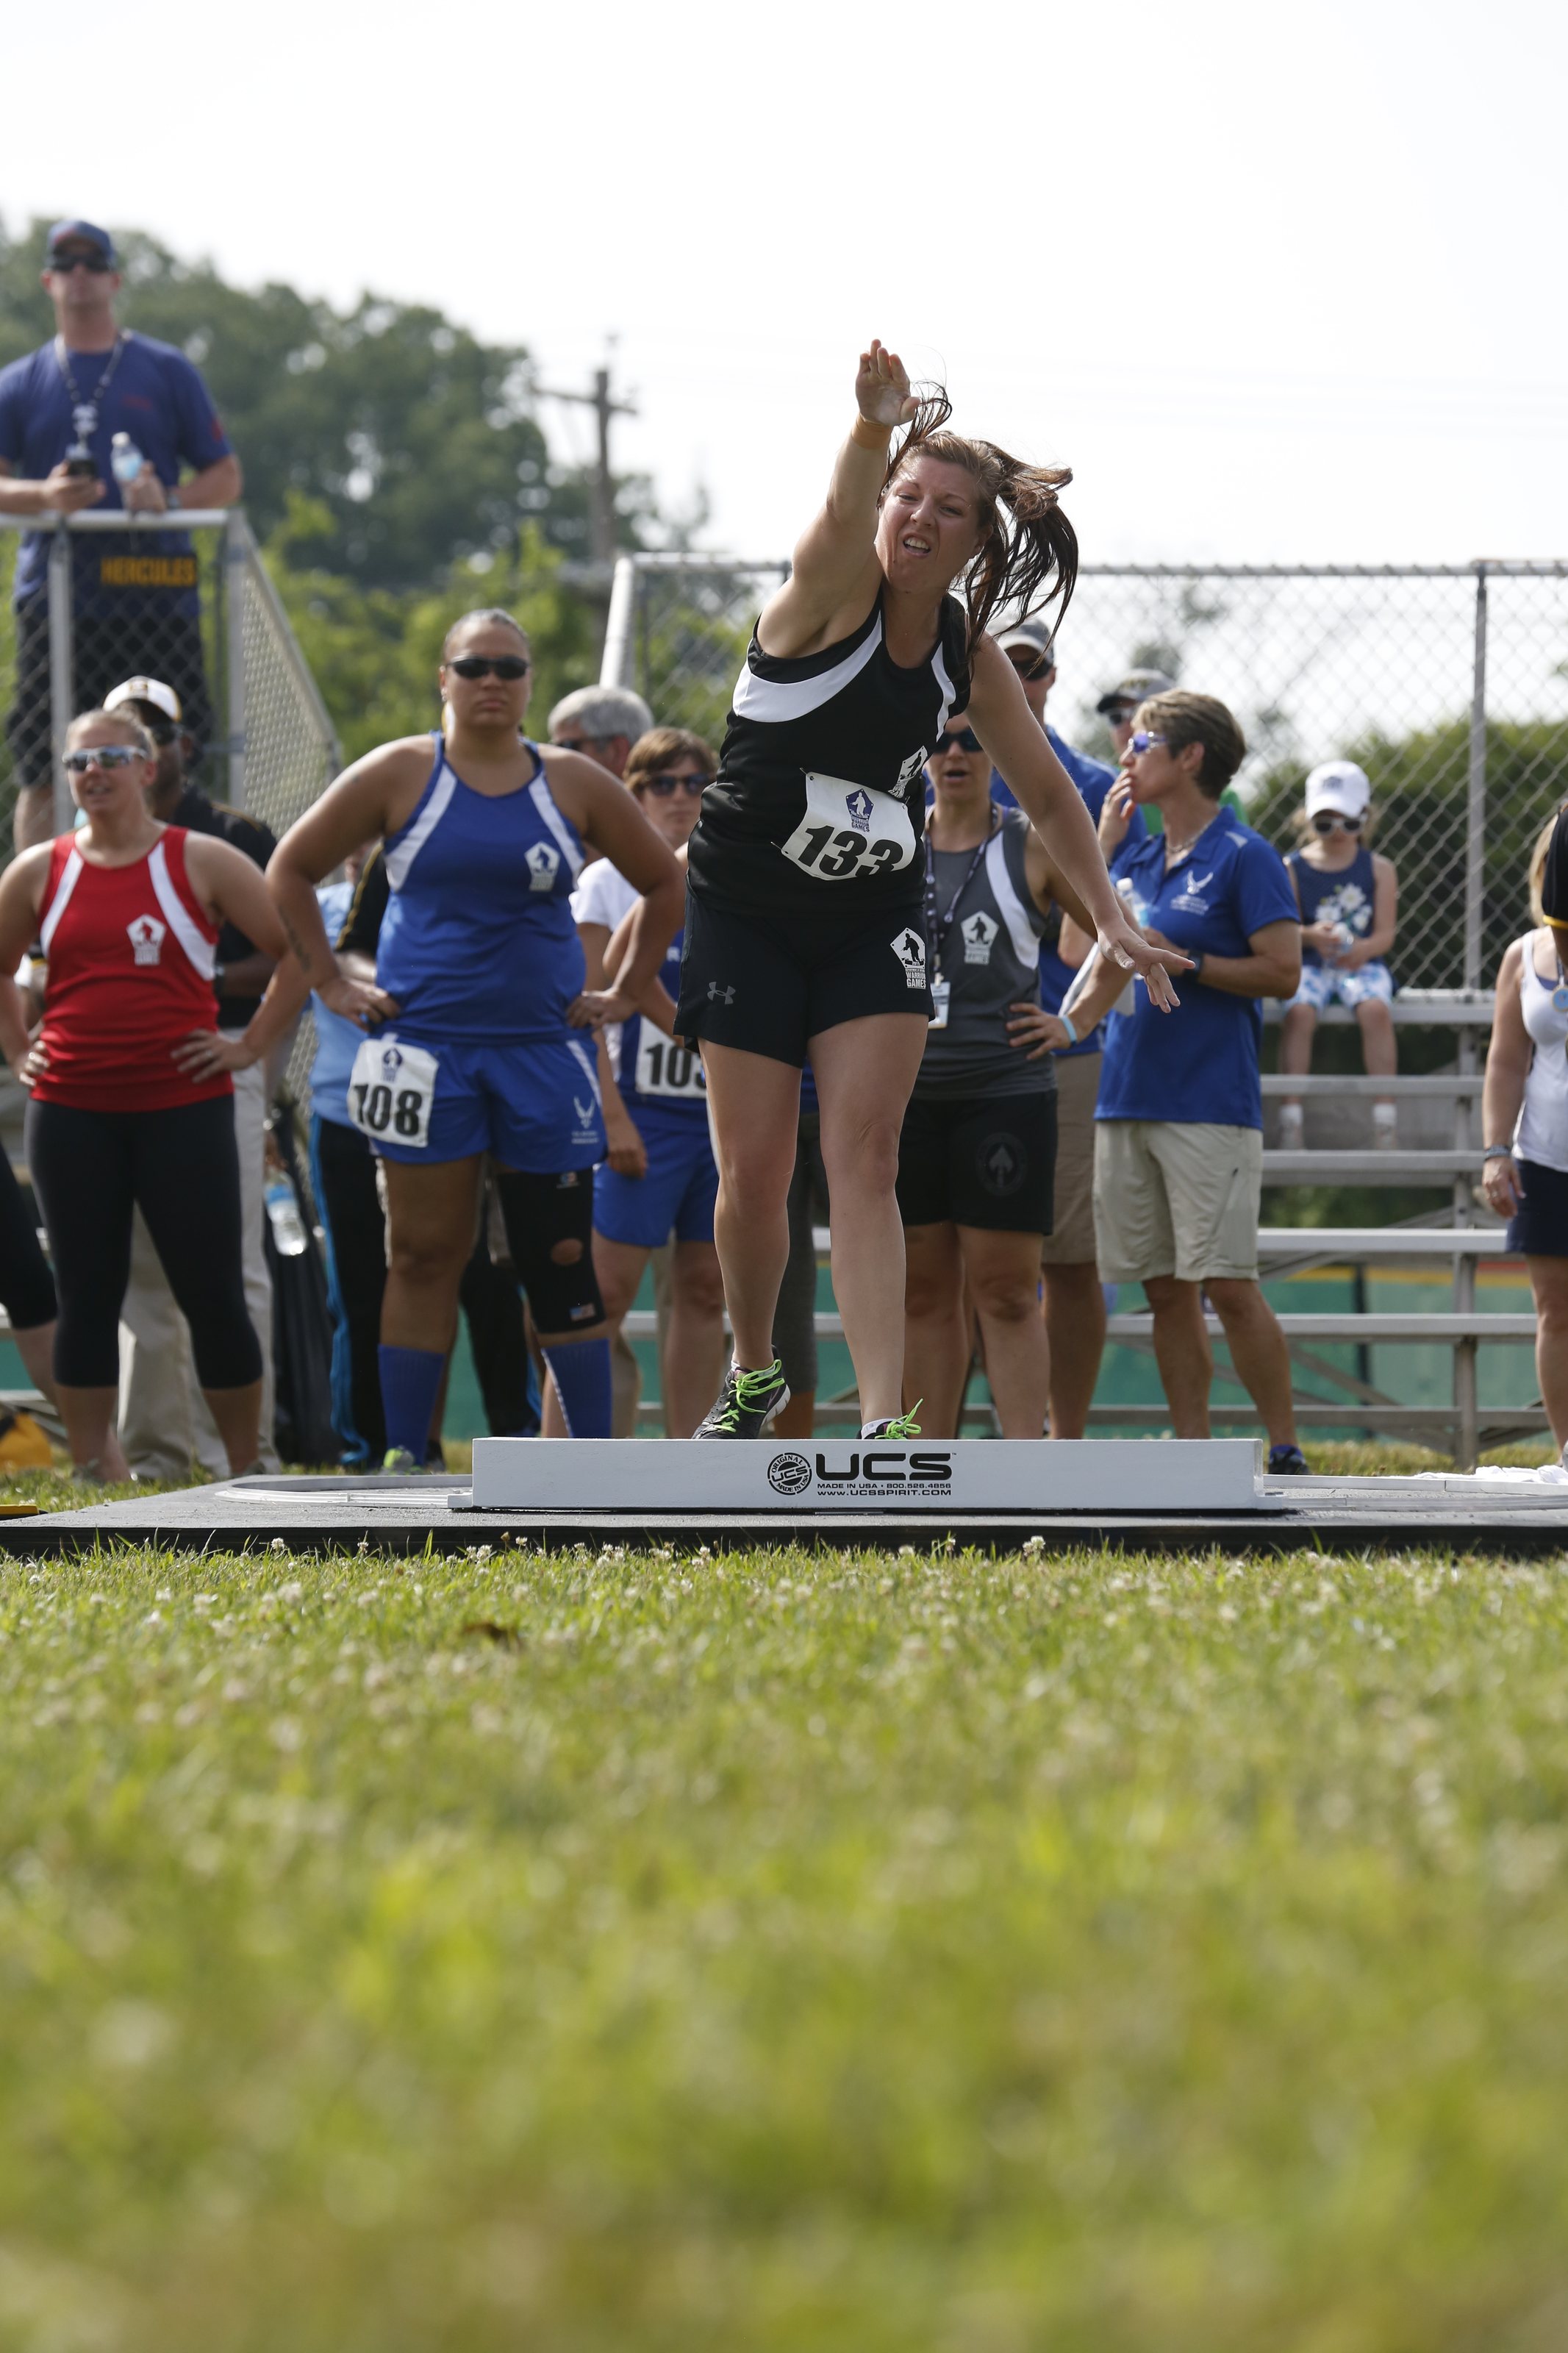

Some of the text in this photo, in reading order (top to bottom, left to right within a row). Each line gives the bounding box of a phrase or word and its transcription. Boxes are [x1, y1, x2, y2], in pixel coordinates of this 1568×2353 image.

[101, 557, 196, 586] HERCULES
[851, 822, 870, 832] GAMES
[798, 825, 903, 877] 133
[906, 979, 926, 988] GAMES
[354, 1085, 423, 1136] 108
[772, 1455, 803, 1473] ORIGINAL
[815, 1452, 952, 1480] UCS
[771, 1465, 808, 1482] UCS
[776, 1482, 794, 1492] MADE
[801, 1474, 809, 1486] USA
